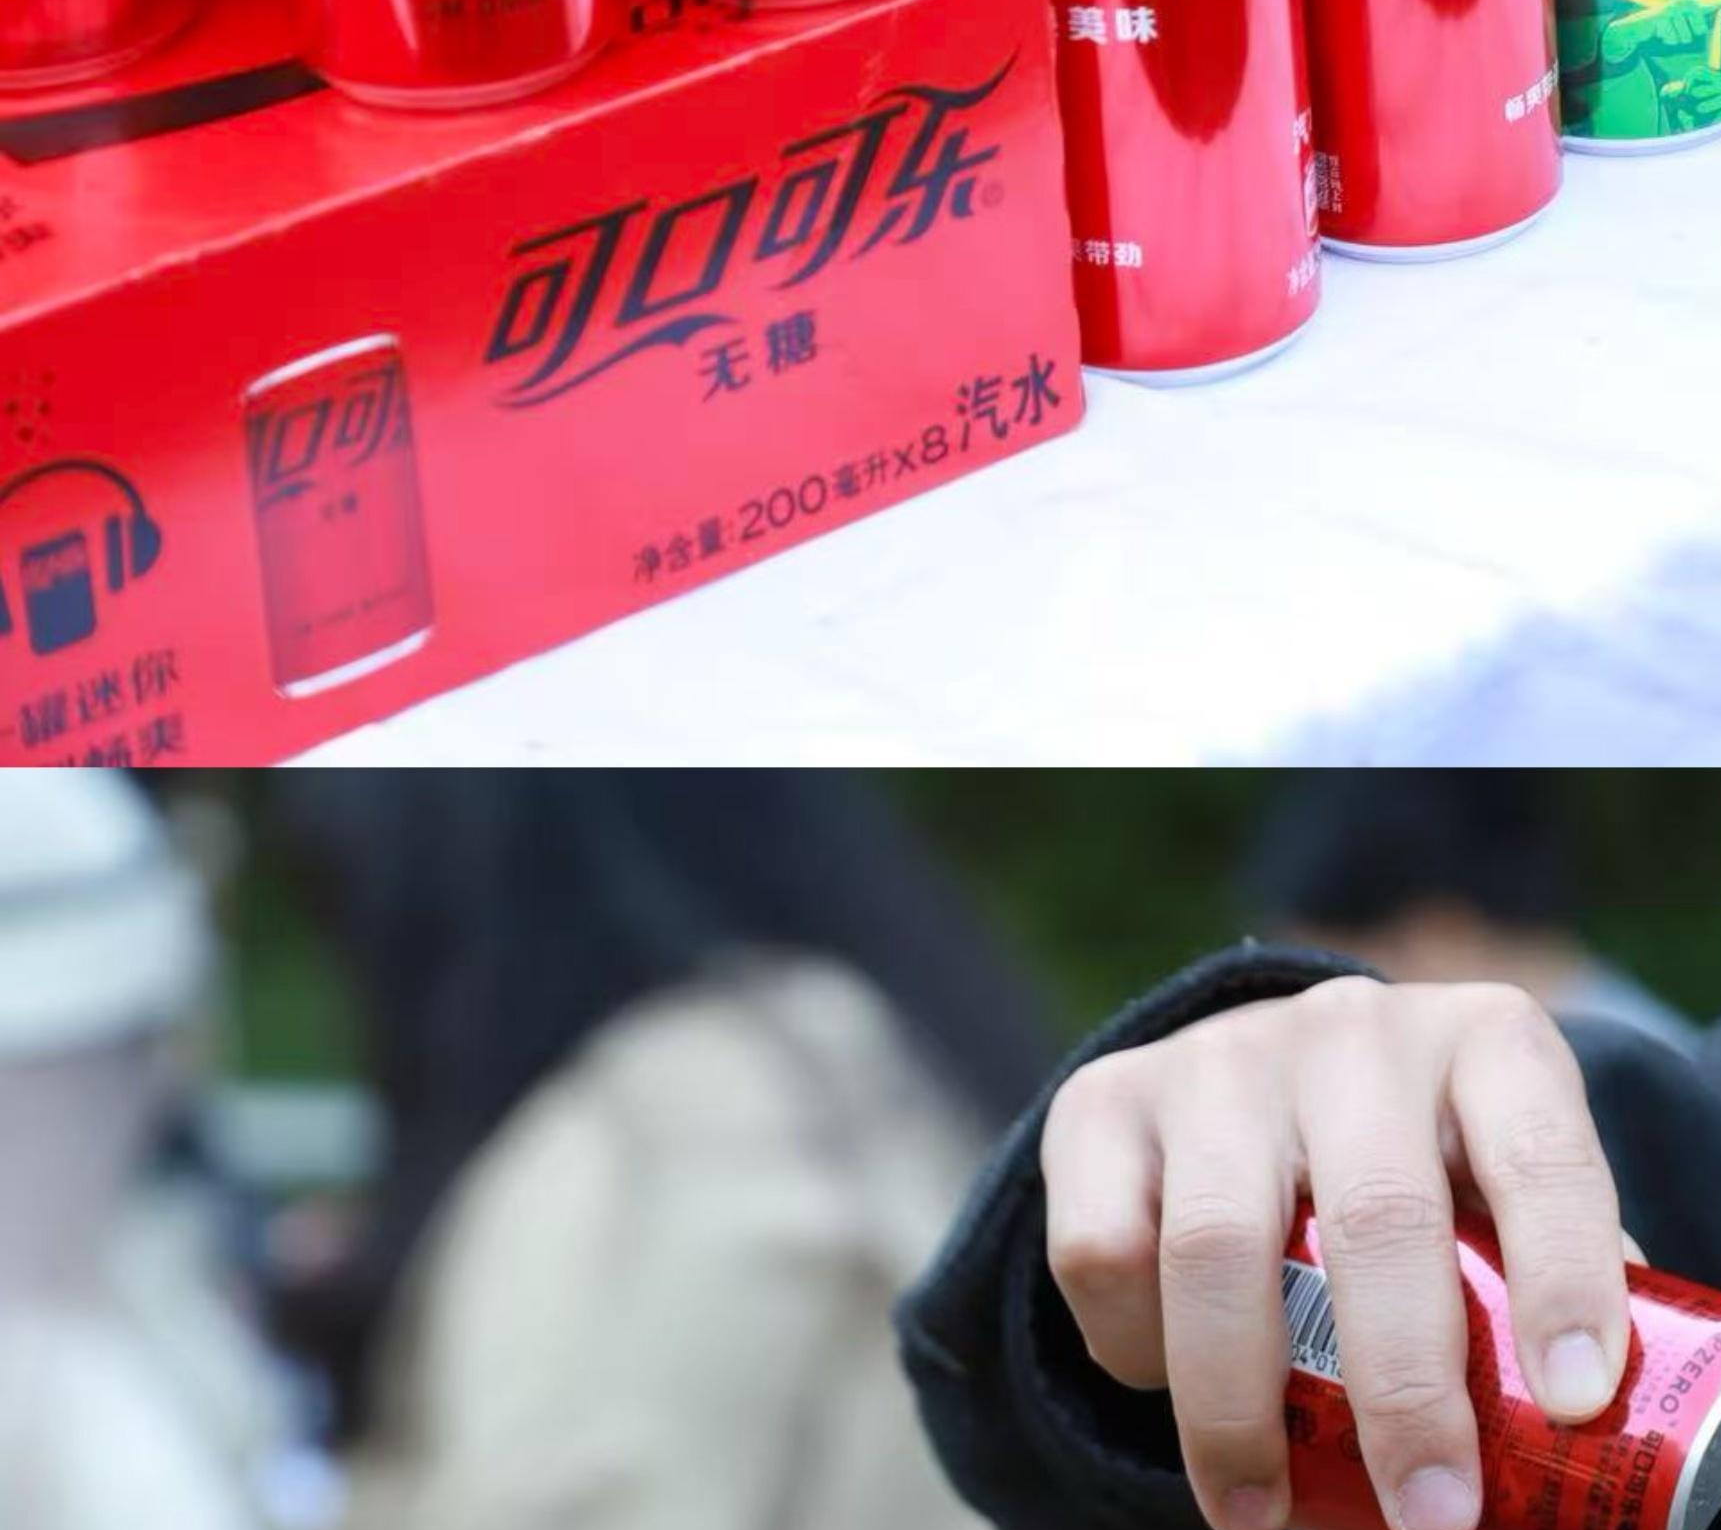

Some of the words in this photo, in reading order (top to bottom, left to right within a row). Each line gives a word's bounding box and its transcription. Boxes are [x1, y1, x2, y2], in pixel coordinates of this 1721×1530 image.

[1068, 6, 1158, 44] 美味
[484, 47, 1013, 396] 可口可乐
[700, 309, 819, 403] 无糖
[954, 352, 1063, 453] 汽水
[1660, 1346, 1716, 1415] ZERO
